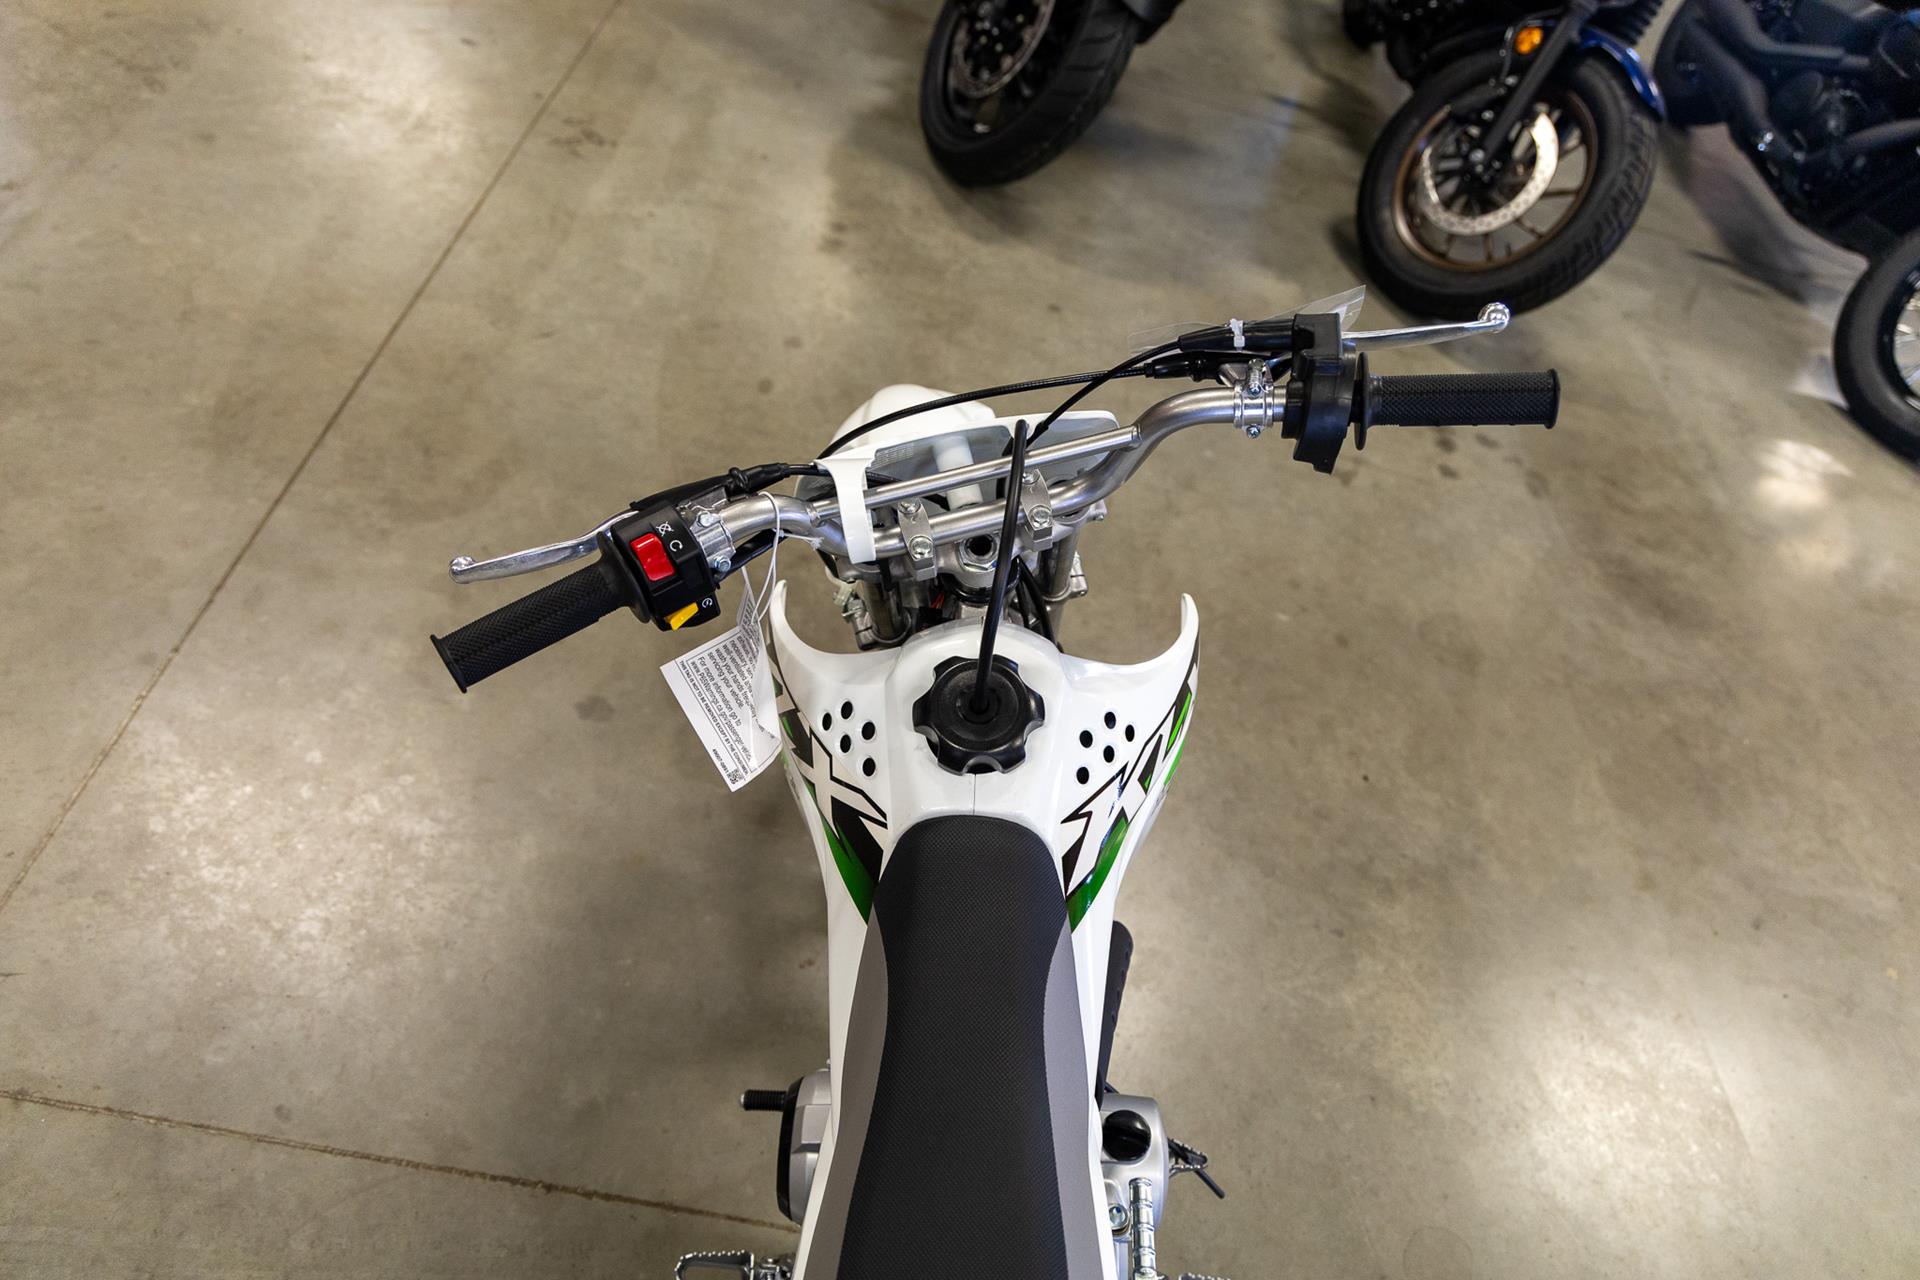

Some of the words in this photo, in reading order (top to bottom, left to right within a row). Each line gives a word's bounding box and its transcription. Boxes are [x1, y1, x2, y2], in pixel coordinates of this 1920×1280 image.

[697, 655, 708, 667] For
[703, 666, 715, 682] more
[712, 680, 734, 712] information
[728, 711, 738, 721] go
[720, 675, 732, 690] your
[721, 662, 734, 676] your
[730, 674, 745, 692] hands
